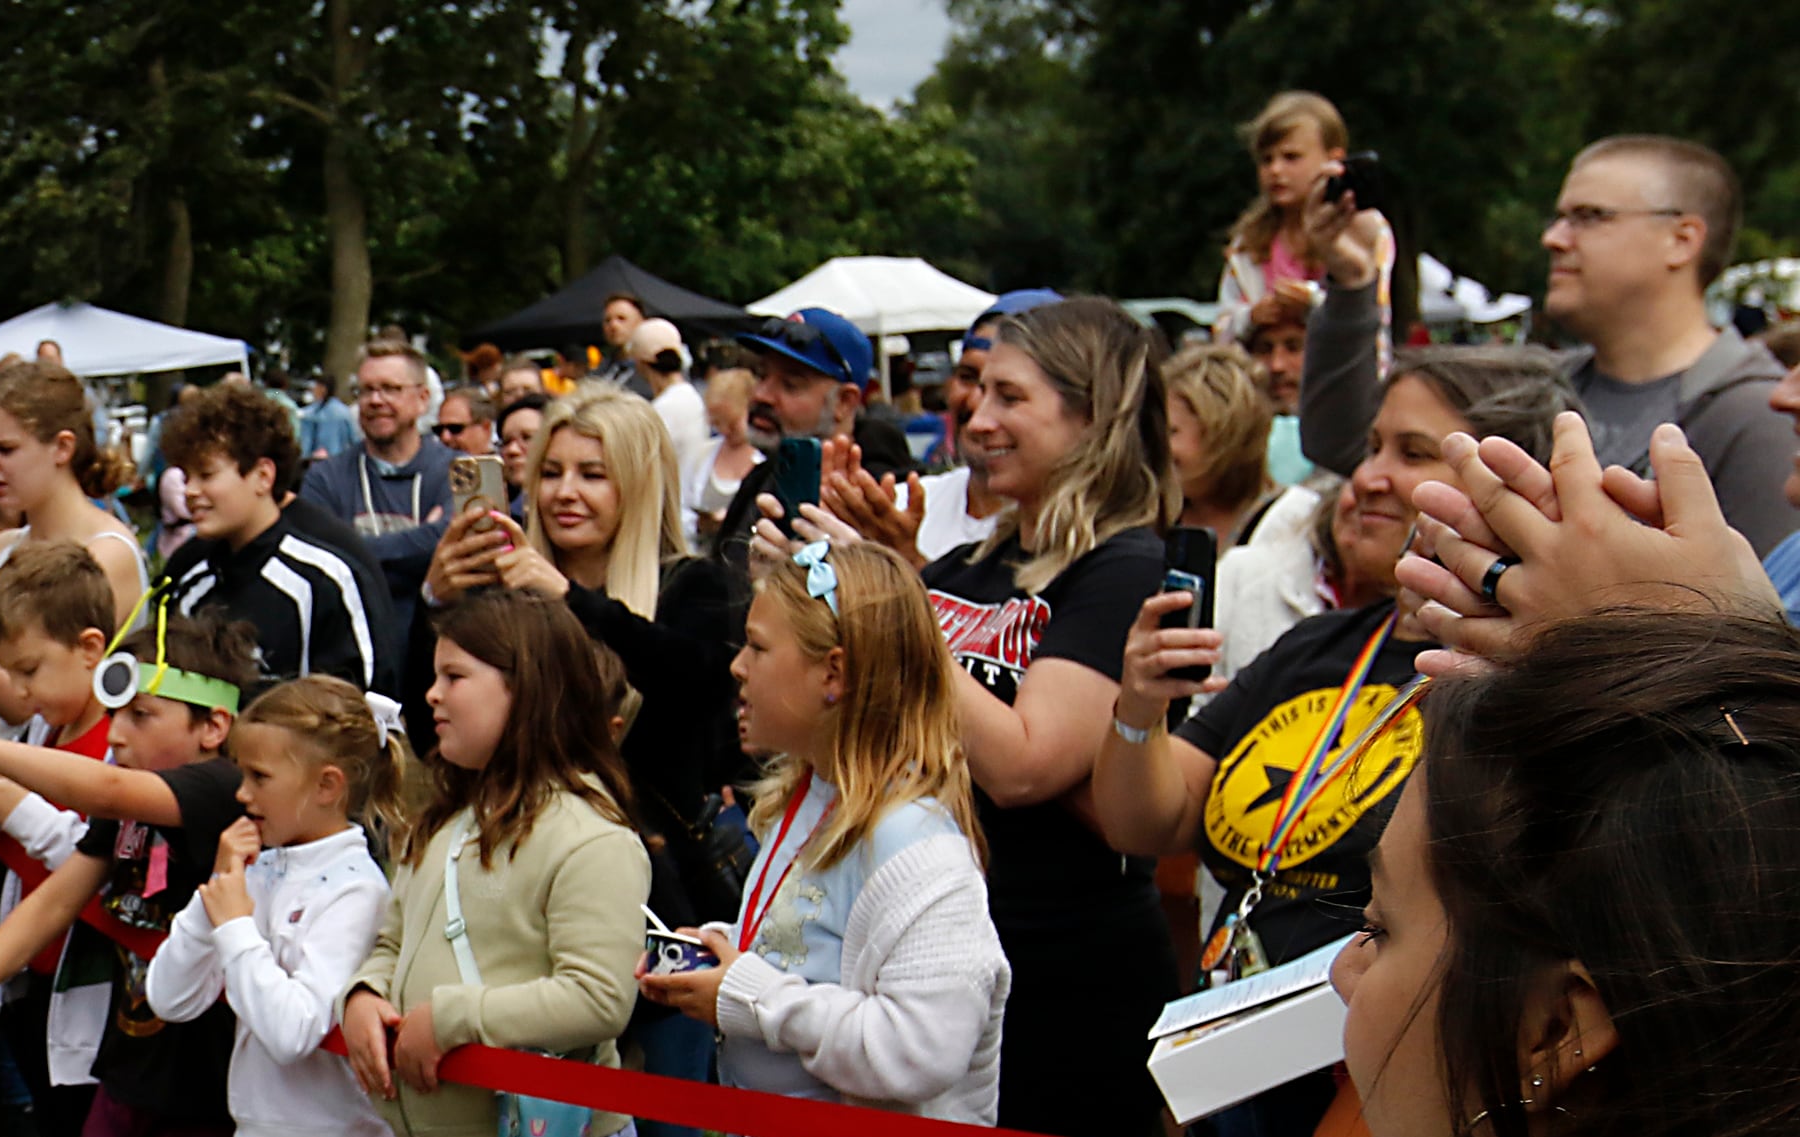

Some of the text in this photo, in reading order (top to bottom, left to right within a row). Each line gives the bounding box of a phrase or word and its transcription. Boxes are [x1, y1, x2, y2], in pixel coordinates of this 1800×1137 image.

[1260, 706, 1300, 739] THIS
[1307, 696, 1327, 714] IS
[1219, 826, 1250, 858] THE
